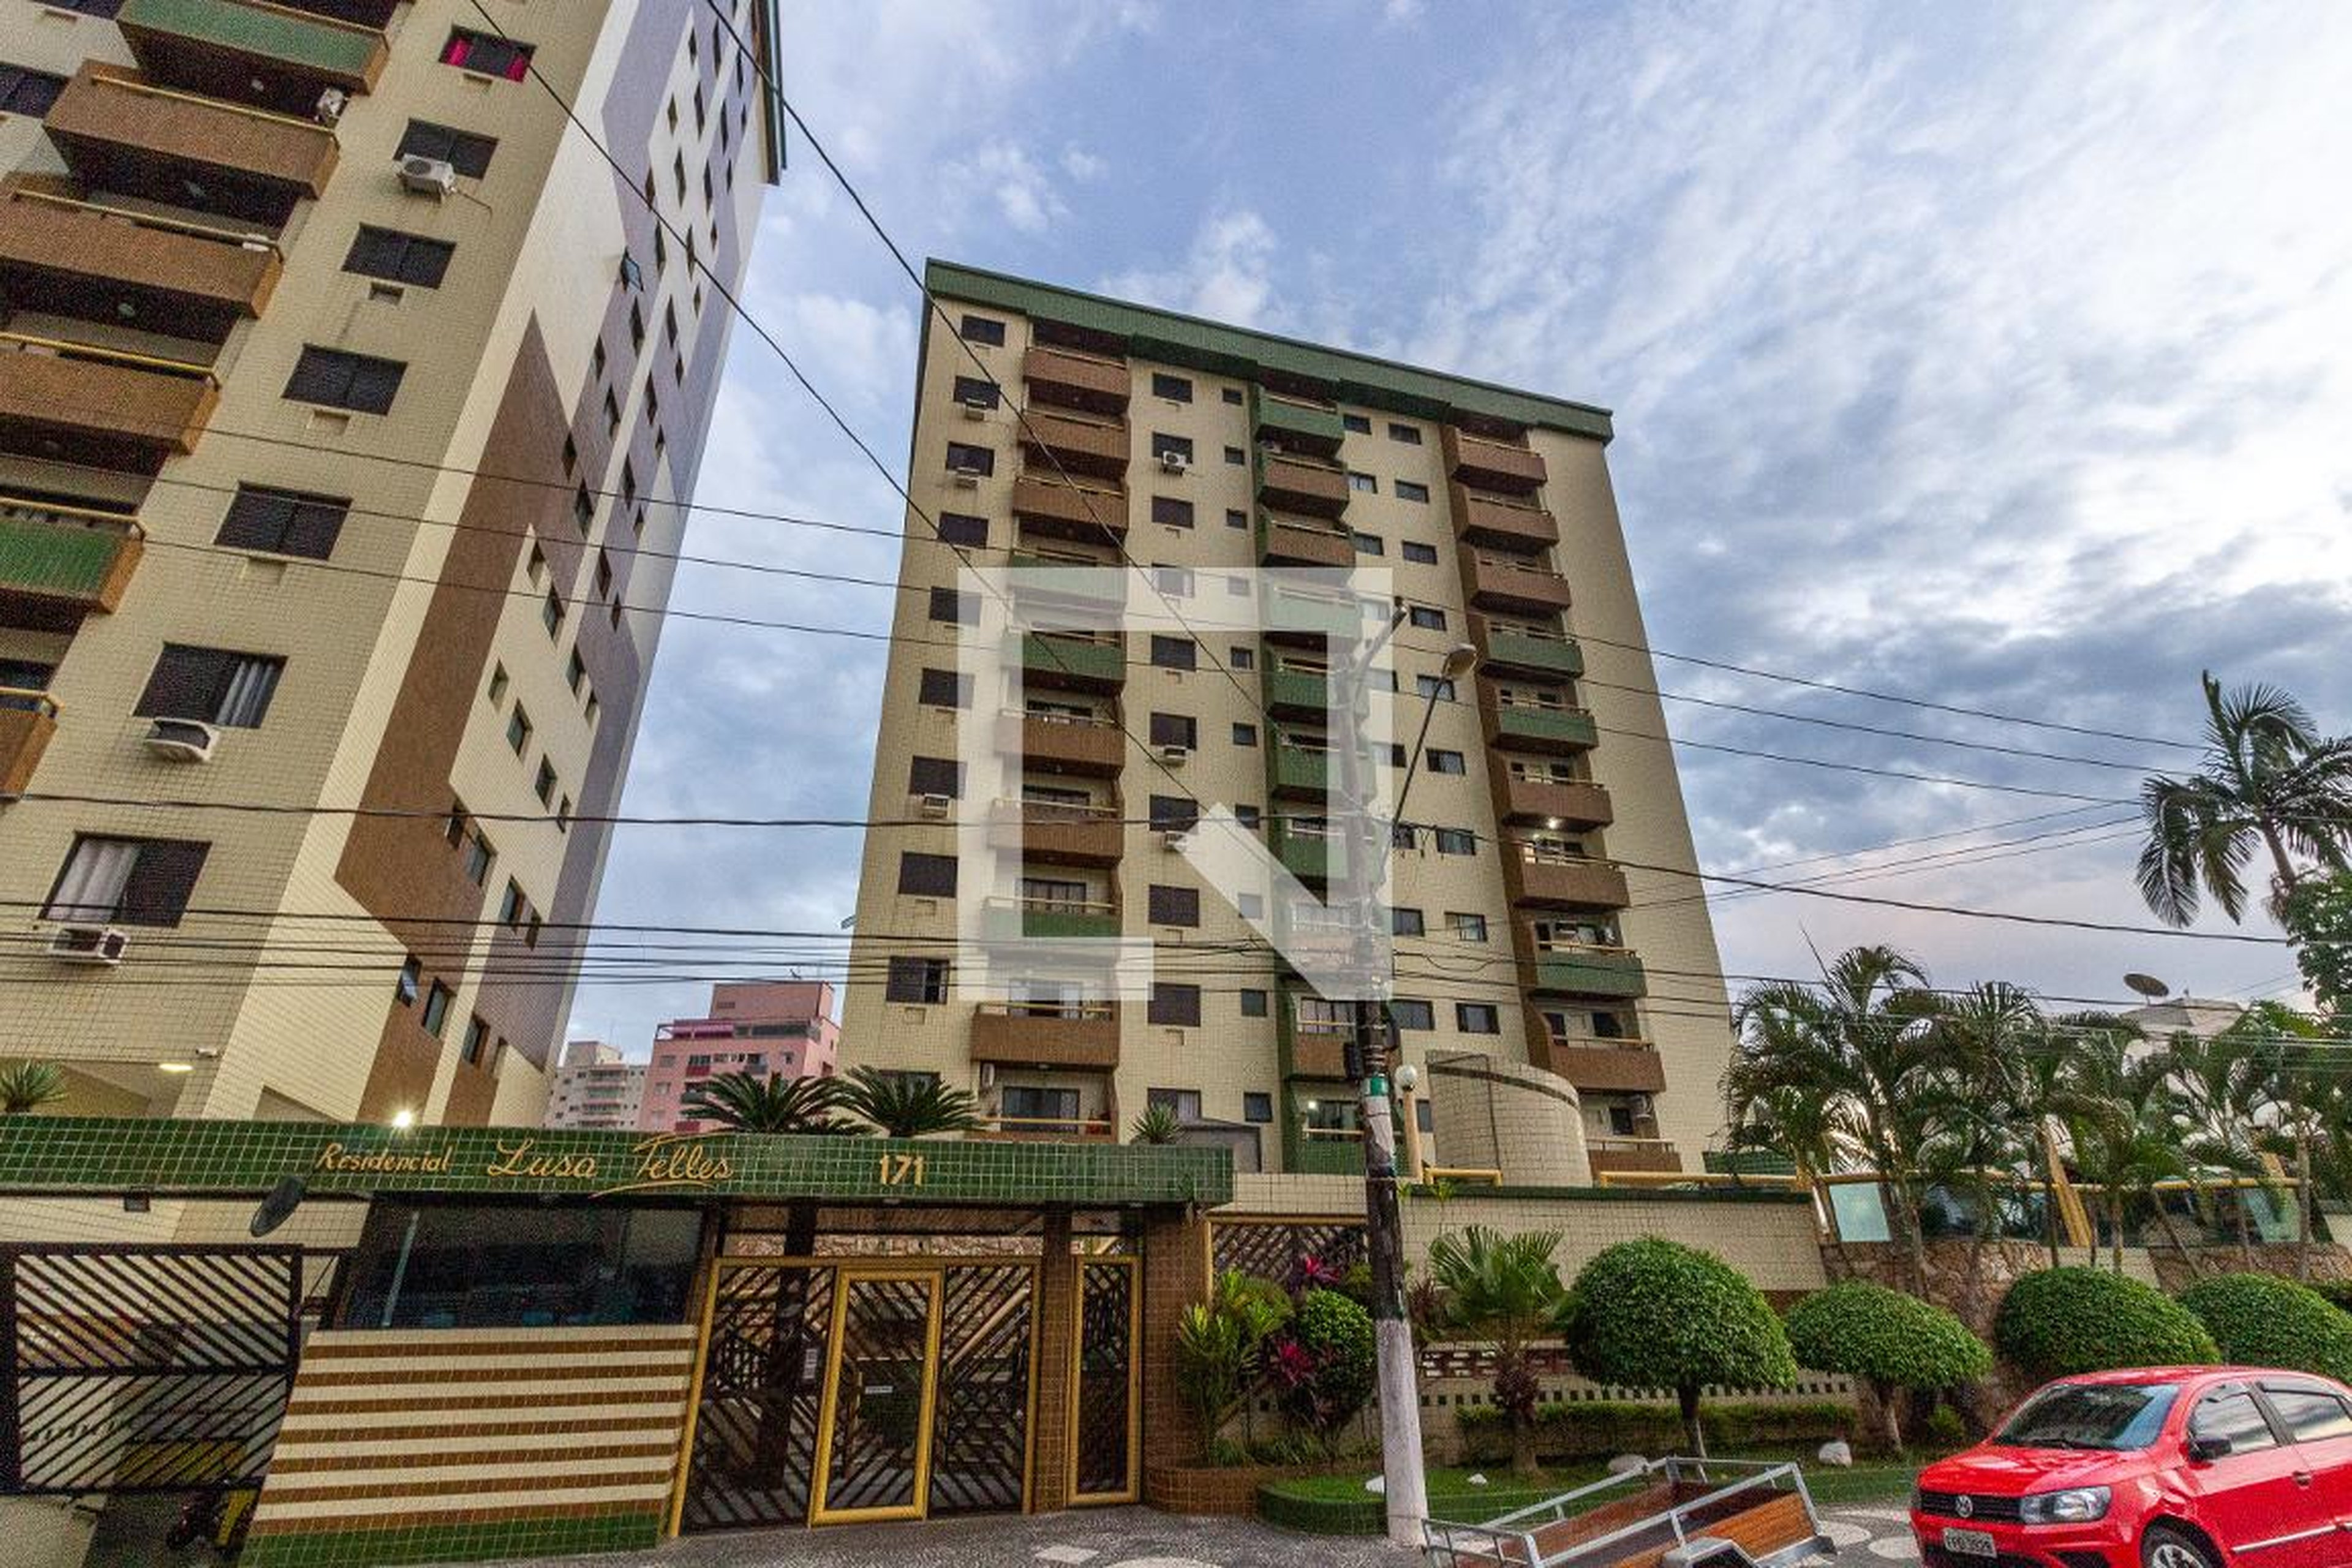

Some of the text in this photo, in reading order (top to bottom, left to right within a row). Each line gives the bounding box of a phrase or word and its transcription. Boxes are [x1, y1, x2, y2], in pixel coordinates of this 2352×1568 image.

[315, 1142, 453, 1171] Residencial
[633, 1133, 735, 1179] Telles
[880, 1155, 923, 1185] 171
